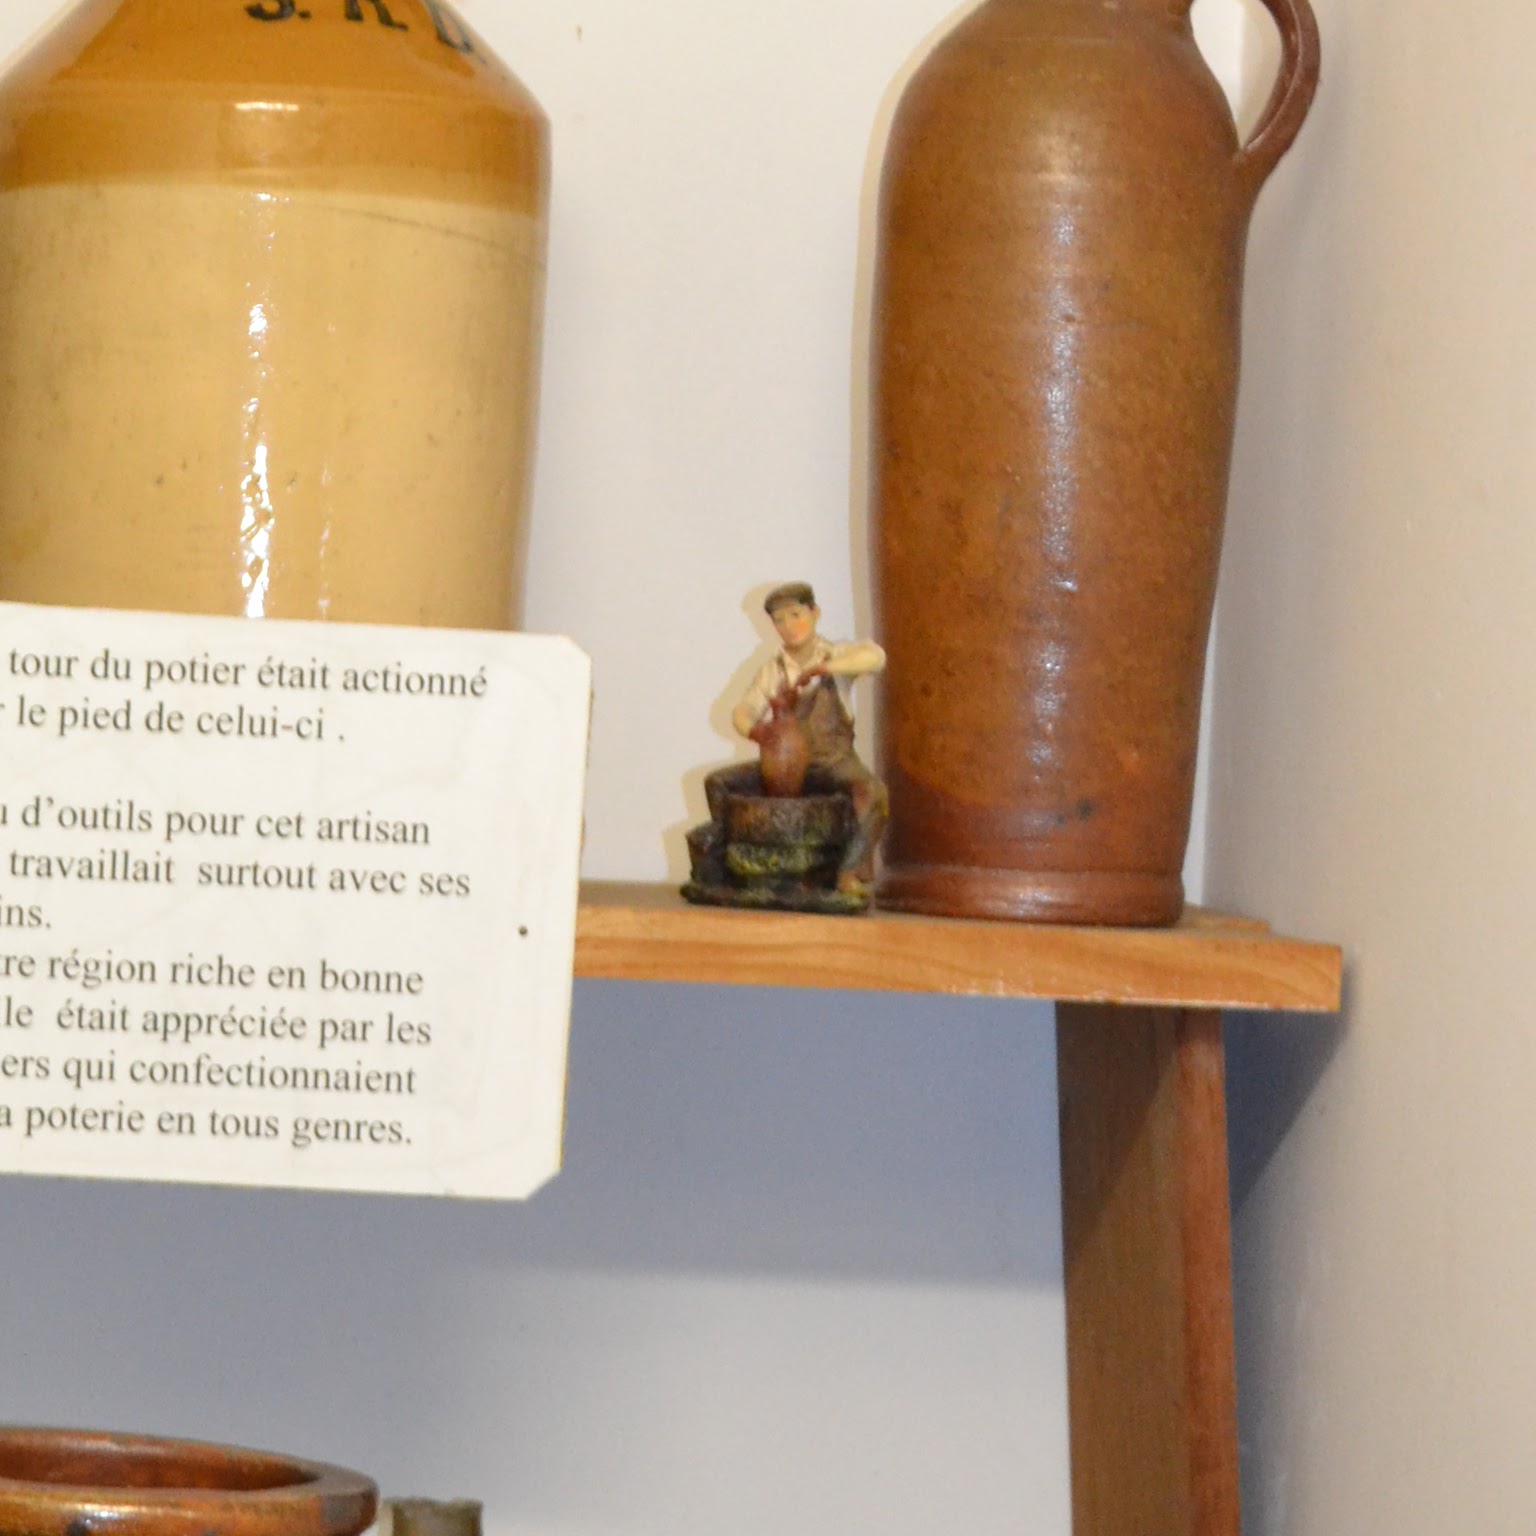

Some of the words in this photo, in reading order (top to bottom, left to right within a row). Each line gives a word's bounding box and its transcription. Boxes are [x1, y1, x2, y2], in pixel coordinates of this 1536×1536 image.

[8, 649, 80, 679] tour
[89, 647, 132, 682] du
[144, 651, 247, 692] potier
[256, 655, 329, 691] était
[341, 661, 488, 699] actionné
[17, 693, 47, 729] le
[58, 696, 133, 738] pied
[143, 700, 186, 735] de
[164, 810, 246, 843] pour
[254, 813, 304, 840] cet
[315, 809, 431, 846] artisan
[9, 848, 174, 885] travaillait
[197, 861, 316, 891] surtout
[327, 868, 407, 895] avec
[418, 873, 471, 897] ses
[48, 947, 157, 990] région
[170, 952, 256, 989] riche
[266, 966, 307, 990] en
[319, 958, 425, 996] bonne
[55, 998, 129, 1033] était
[141, 1004, 308, 1045] appréciée
[318, 1018, 375, 1050] par
[386, 1011, 432, 1046] les
[61, 1049, 116, 1090] qui
[128, 1053, 415, 1095] confectionnaient
[24, 1099, 146, 1139] poterie
[155, 1111, 196, 1136] en
[209, 1110, 280, 1139] tous
[290, 1118, 412, 1149] genres.
